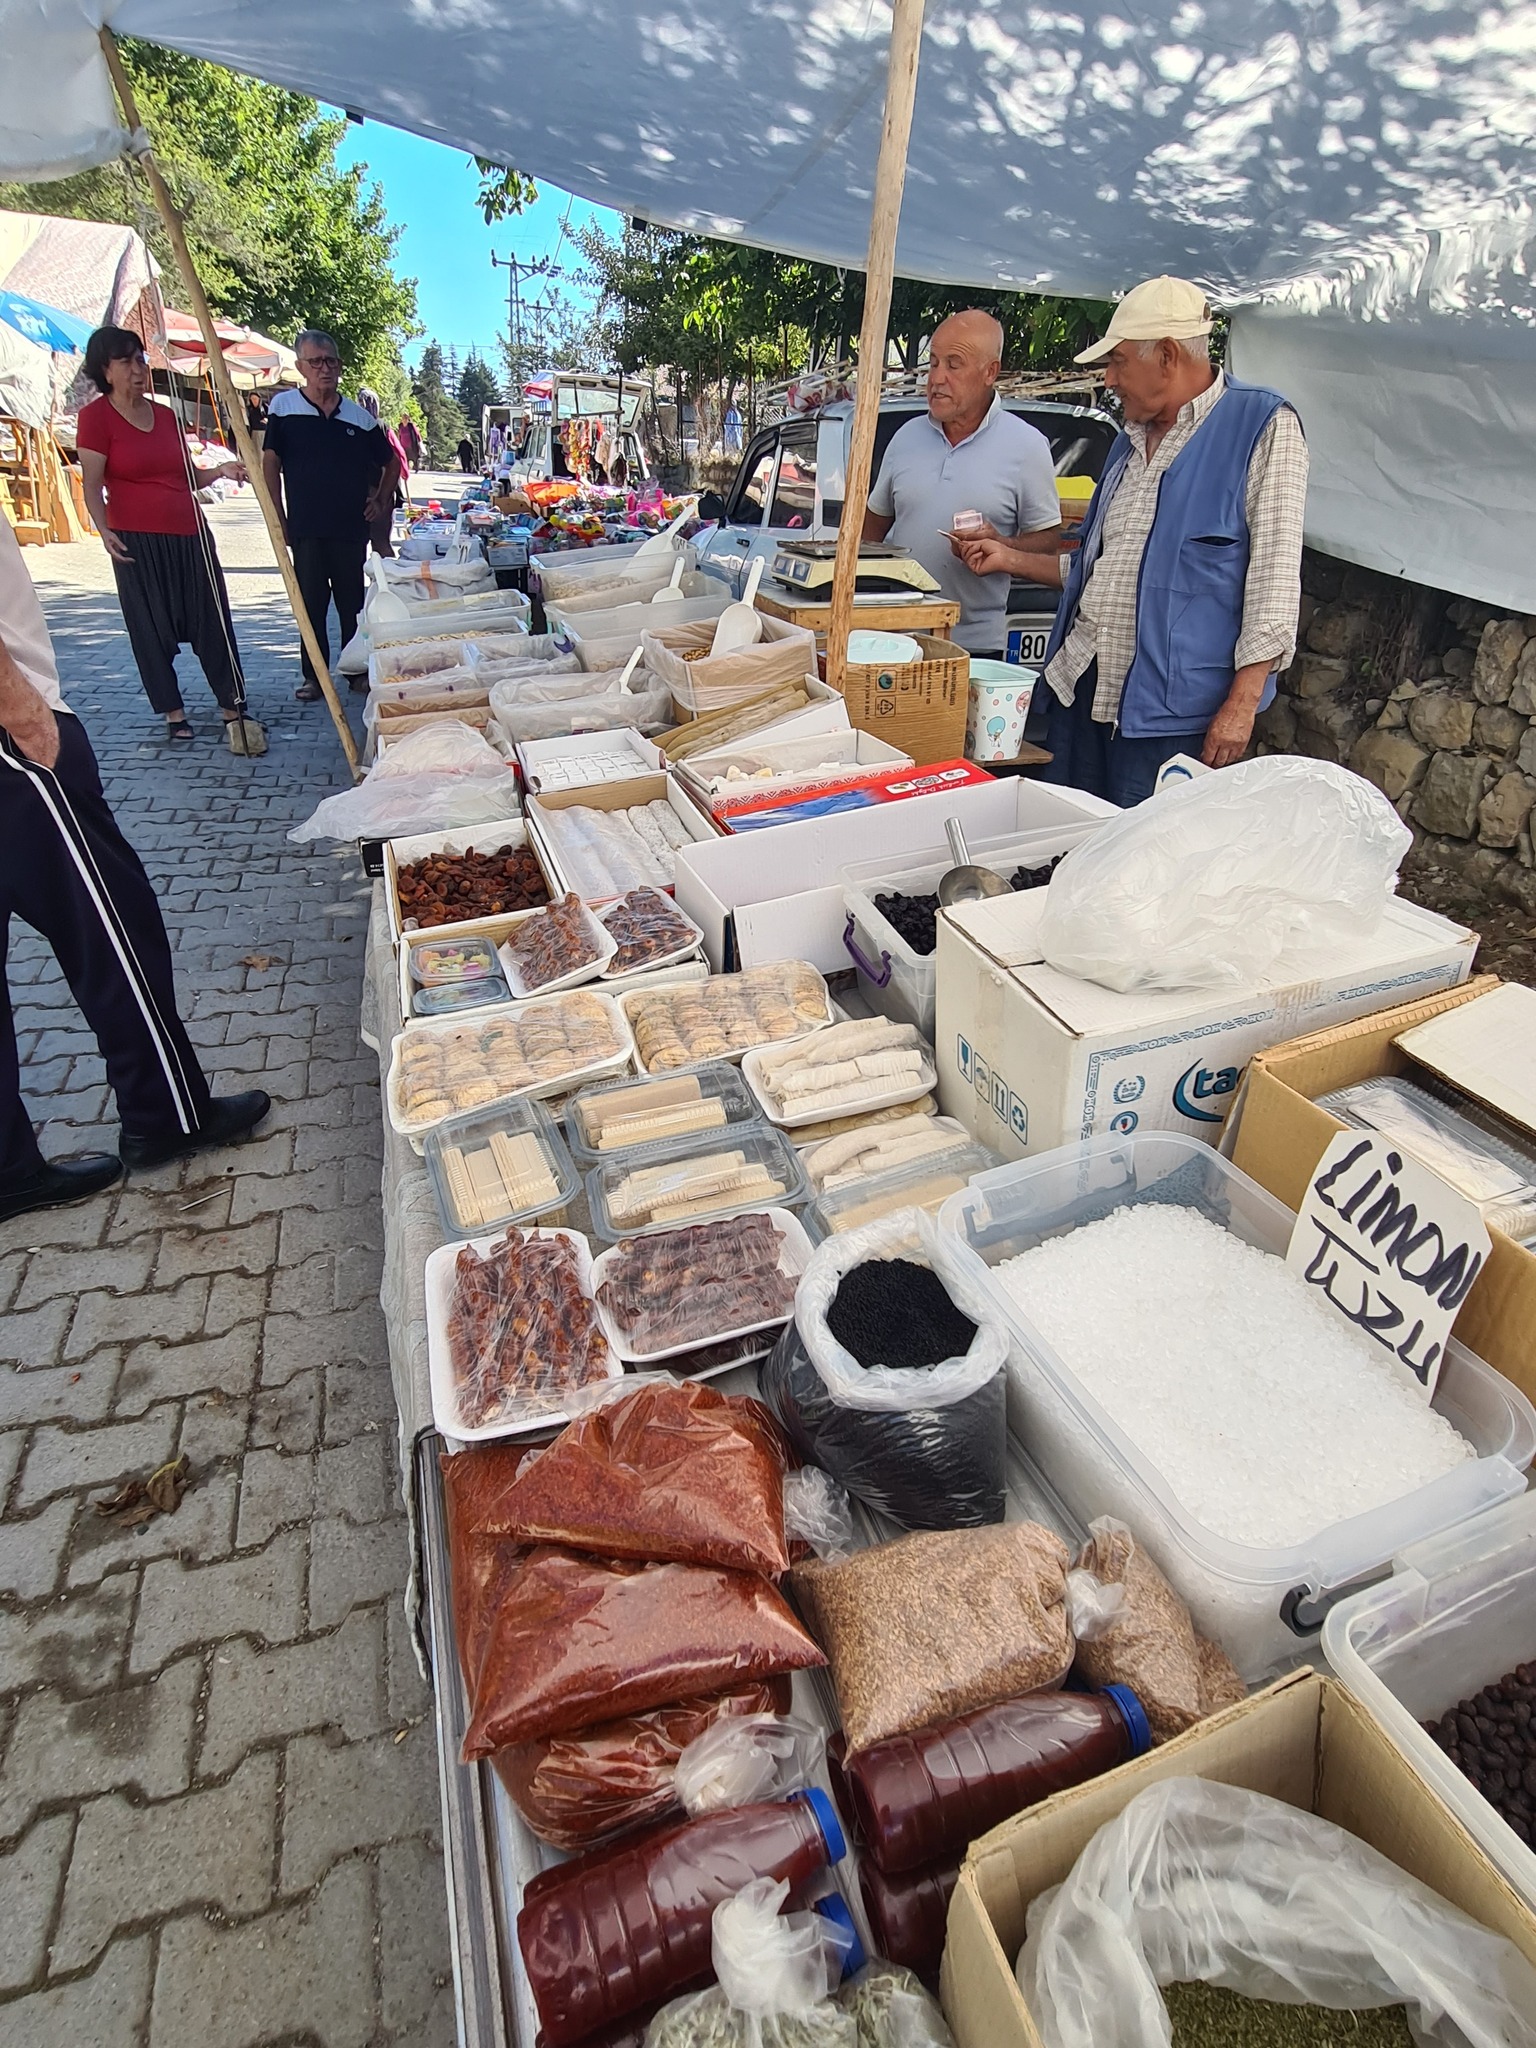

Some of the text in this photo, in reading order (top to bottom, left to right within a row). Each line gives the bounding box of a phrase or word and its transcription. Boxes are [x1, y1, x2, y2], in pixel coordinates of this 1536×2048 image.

[1010, 649, 1019, 657] TR
[1021, 634, 1046, 660] 80
[1193, 1066, 1244, 1099] ta
[1304, 1214, 1440, 1386] TUZU
